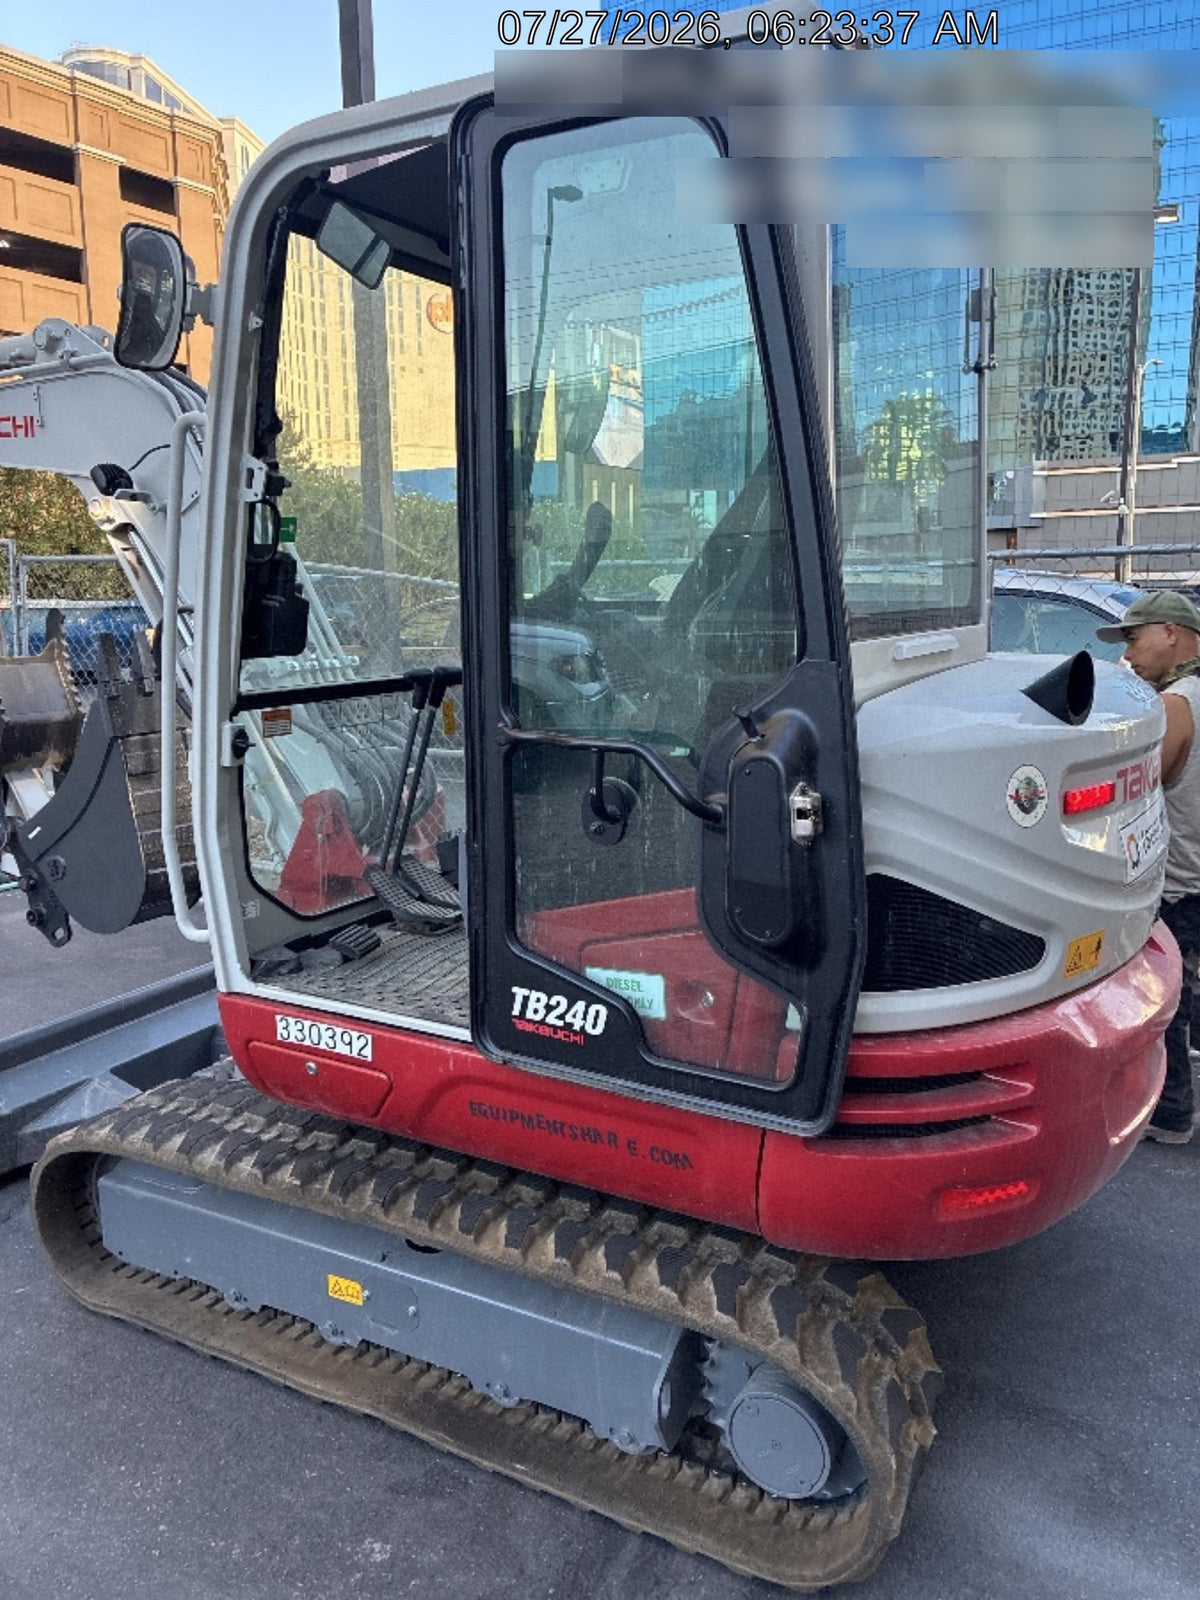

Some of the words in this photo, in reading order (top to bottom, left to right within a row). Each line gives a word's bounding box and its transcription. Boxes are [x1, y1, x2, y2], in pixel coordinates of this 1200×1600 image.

[605, 976, 645, 993] DIESEL
[511, 986, 608, 1036] TB240
[278, 1016, 369, 1059] 330392
